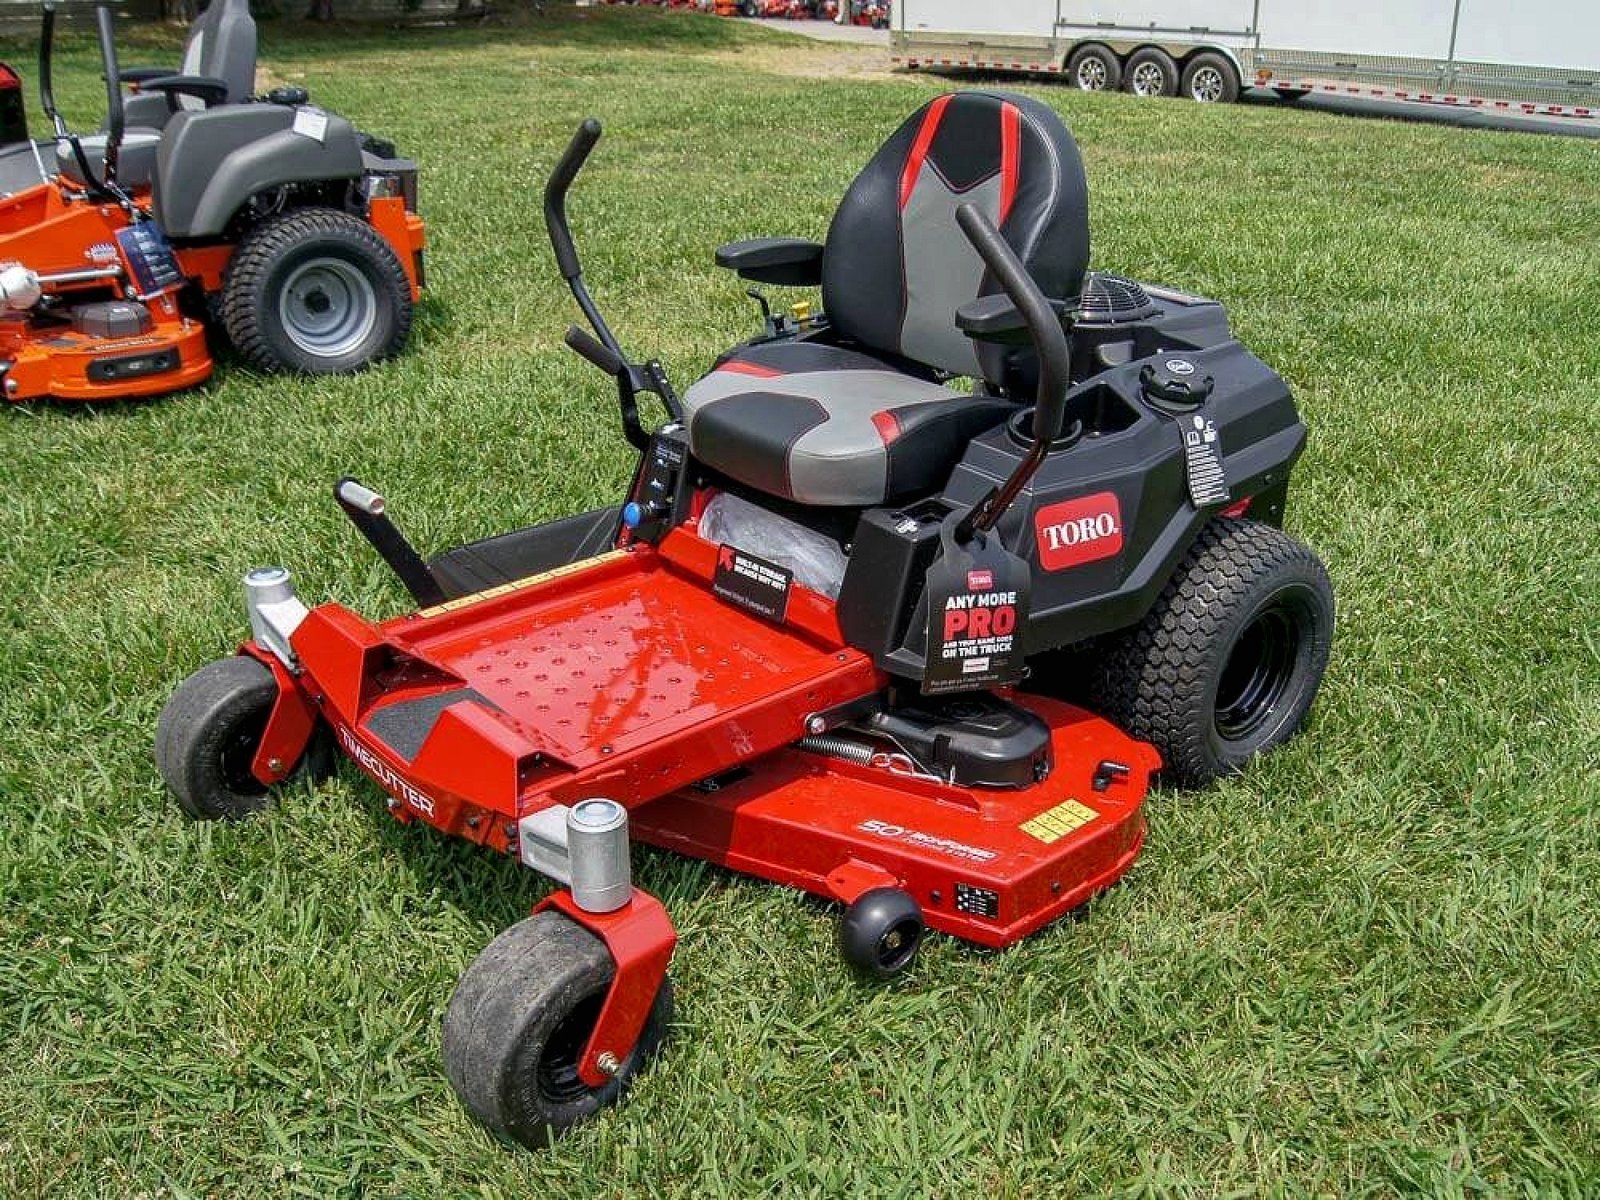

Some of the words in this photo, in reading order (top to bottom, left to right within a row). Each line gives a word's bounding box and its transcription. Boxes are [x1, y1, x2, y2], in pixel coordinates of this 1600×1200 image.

[945, 595, 976, 610] ANY
[977, 592, 1017, 607] MORE
[944, 607, 1016, 641] PRO
[942, 647, 958, 658] ON
[958, 646, 979, 657] THE
[979, 642, 1012, 655] TRUCK
[340, 726, 436, 819] TIMECUTTER
[857, 819, 904, 838] 50
